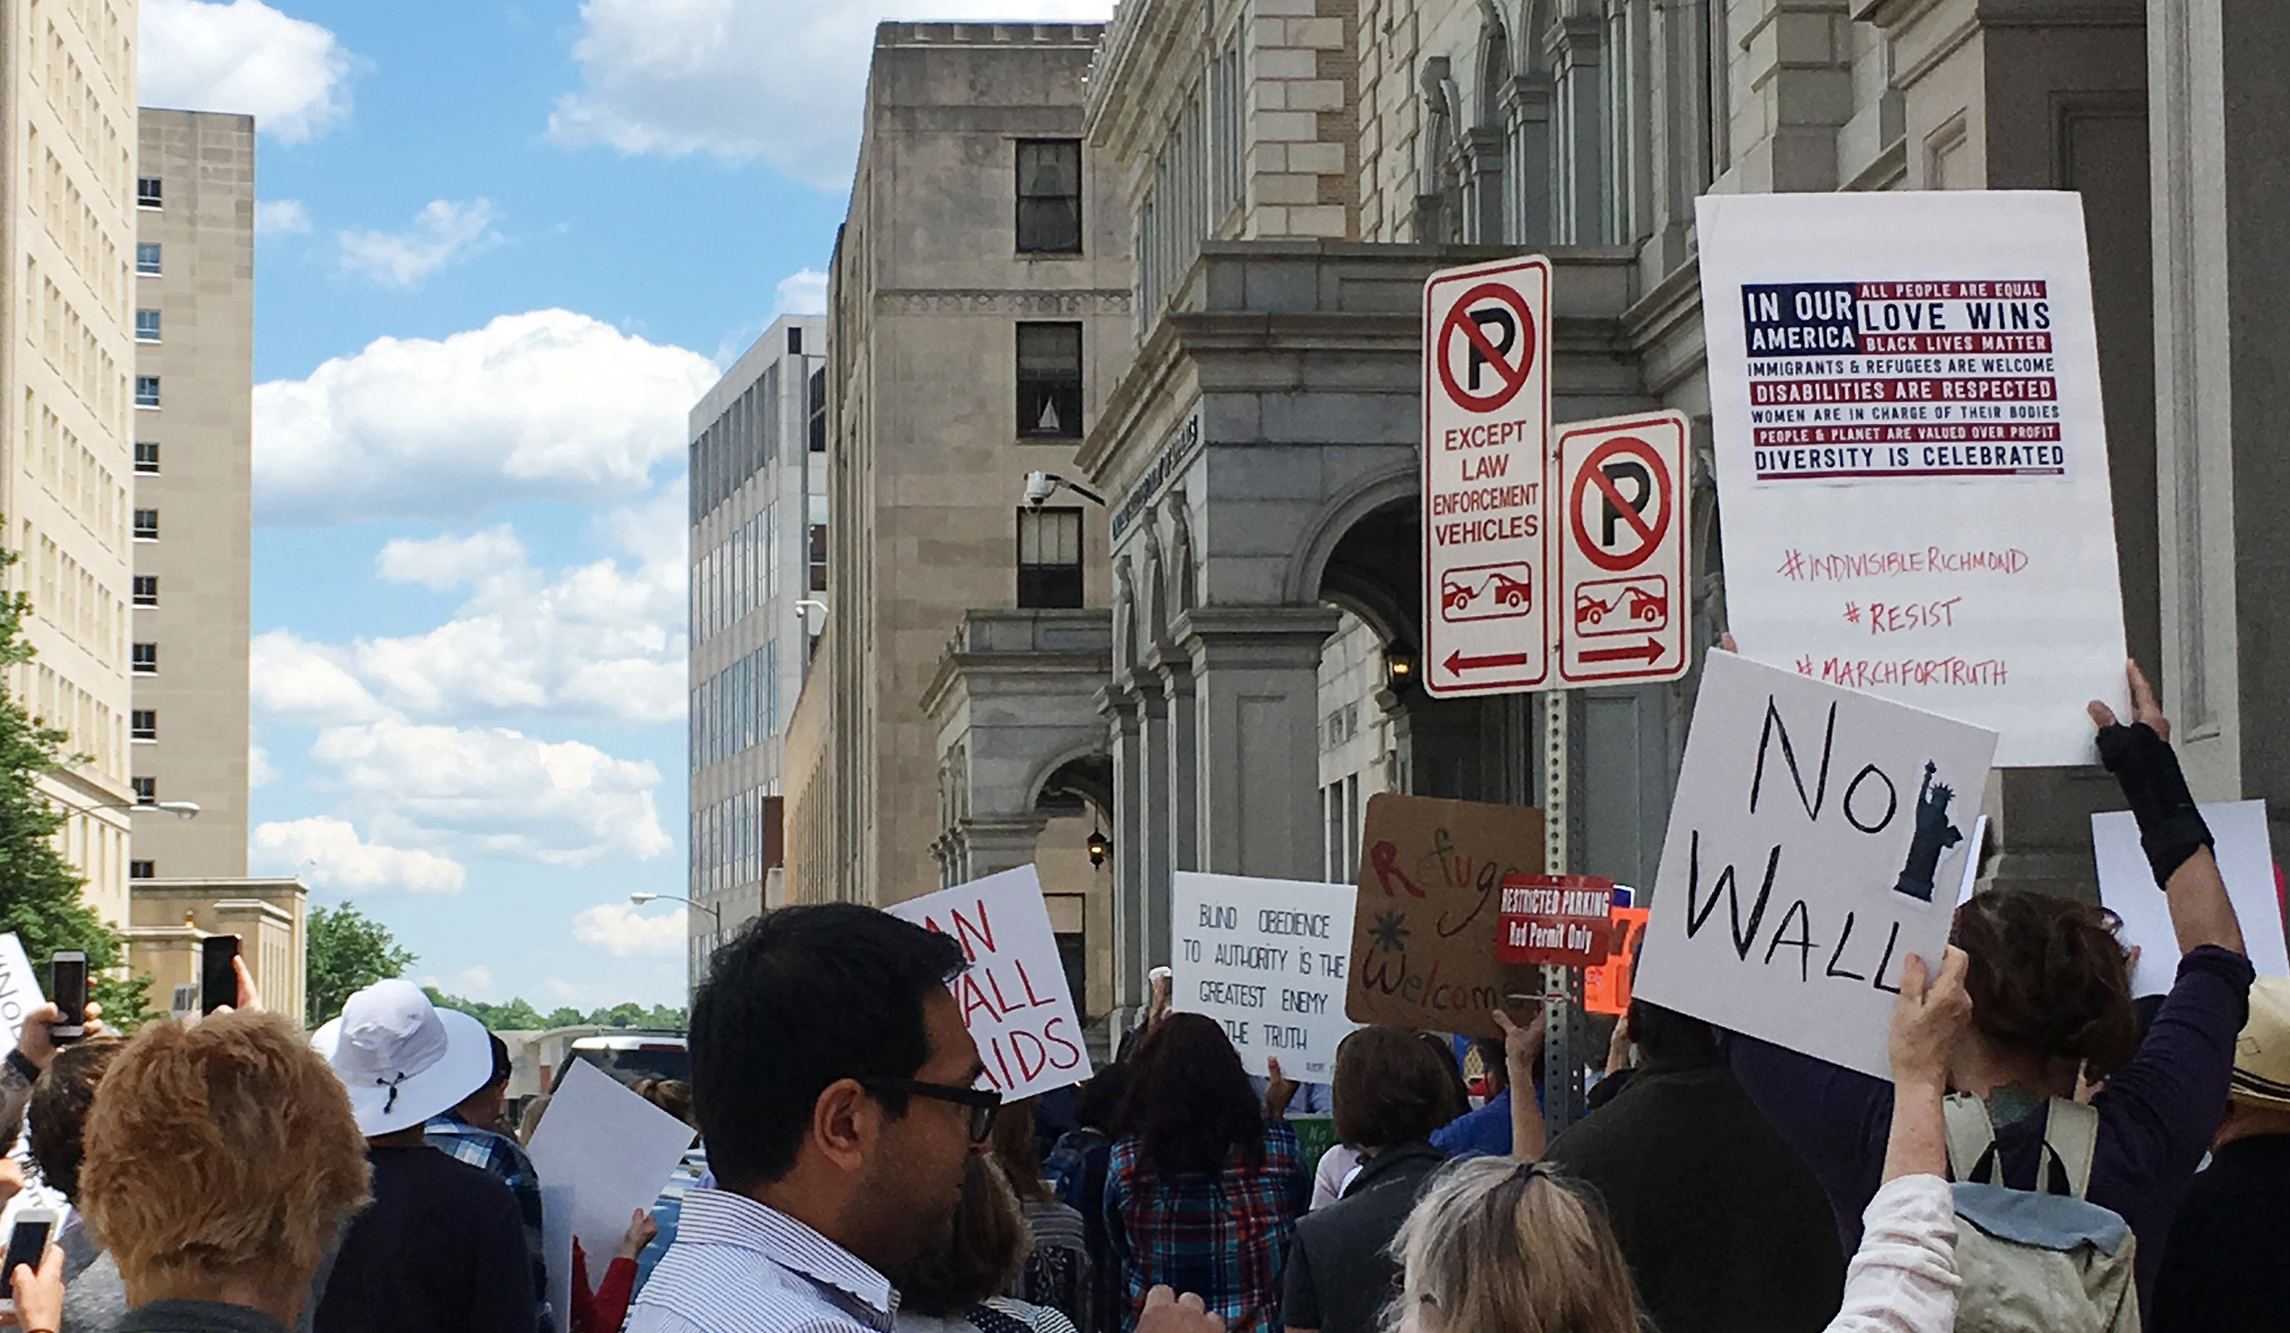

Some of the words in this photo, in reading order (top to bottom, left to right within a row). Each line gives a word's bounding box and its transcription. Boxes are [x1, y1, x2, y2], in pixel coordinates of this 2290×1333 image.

[1861, 284, 1888, 298] ALL
[1896, 284, 1951, 297] PEOPLE
[1959, 283, 1988, 297] ARE
[1995, 283, 2040, 297] EQUAL
[1748, 292, 1779, 322] IN
[1795, 291, 1853, 320] OUR
[1864, 302, 1945, 331] LOVE
[1966, 302, 2050, 329] WINS
[1753, 326, 1855, 350] AMERICA
[1866, 337, 1917, 351] BLACK
[1926, 336, 1973, 351] LIVES
[1982, 336, 2046, 350] MATTER
[1747, 360, 1844, 377] IMMIGRANTS
[1850, 360, 1860, 374] &
[1866, 359, 1942, 374] REFUGEES
[1948, 358, 1976, 373] ARE
[1982, 358, 2055, 372] WELCOME
[1756, 382, 1885, 404] DISABILITIES
[1896, 381, 1931, 399] ARE
[1942, 381, 2050, 399] RESPECTED
[1752, 408, 1805, 423] WOMEN
[1814, 407, 1841, 421] ARE
[1850, 407, 1864, 420] IN
[1872, 406, 1927, 420] CHARGE
[1935, 406, 1951, 419] OF
[1960, 405, 2001, 419] THEIR
[2010, 405, 2060, 419] BODIES
[1445, 420, 1526, 451] EXCEPT
[1760, 430, 1809, 443] PEOPLE
[1815, 429, 1825, 441] &
[1831, 428, 1880, 441] PLANET
[1886, 428, 1912, 440] ARE
[1918, 426, 1966, 439] VALUED
[1972, 426, 2005, 439] OVER
[2010, 426, 2054, 439] PROFIT
[1461, 454, 1509, 481] LAW
[1755, 448, 1873, 470] DIVERSITY
[1889, 447, 1909, 467] IS
[1923, 446, 2064, 466] CELEBRATED
[1434, 483, 1539, 516] ENFORCEMENT
[1435, 514, 1538, 547] VEHICLES
[1750, 694, 1897, 833] NO
[1369, 827, 1520, 938] Refug
[1501, 888, 1560, 915] RESTRICTED
[1562, 890, 1610, 917] PARKING
[1687, 830, 1901, 994] WALL
[926, 899, 996, 962] N
[1509, 921, 1527, 946] Red
[1529, 922, 1565, 948] Permit
[1568, 924, 1592, 954] Only
[1183, 939, 1200, 963] TO
[1319, 954, 1345, 979] THE
[954, 959, 1055, 1028] ALL
[1200, 981, 1266, 1008] GREATEST
[1282, 989, 1328, 1015] ENEMY
[1224, 1020, 1249, 1044] THE
[1264, 1024, 1307, 1050] TRUTH
